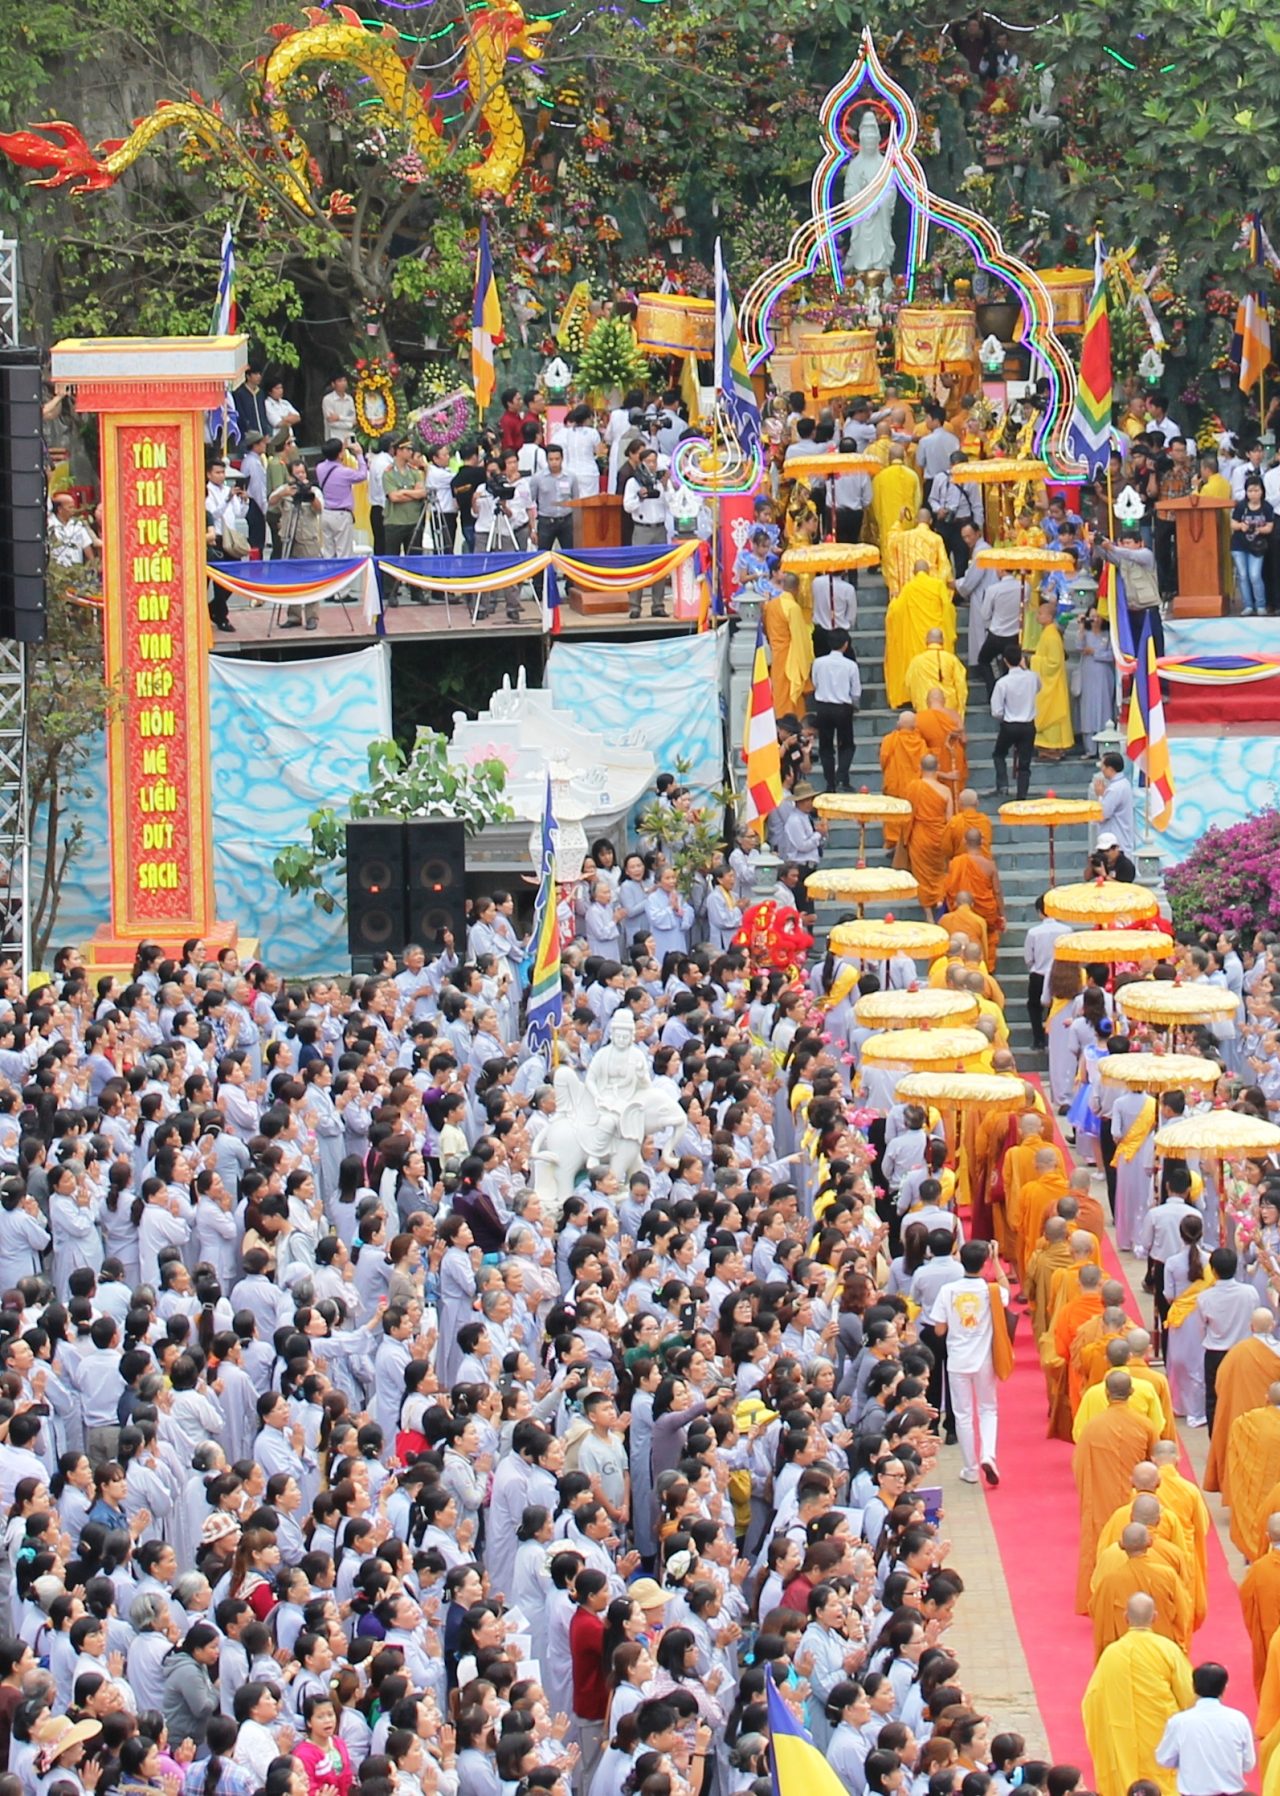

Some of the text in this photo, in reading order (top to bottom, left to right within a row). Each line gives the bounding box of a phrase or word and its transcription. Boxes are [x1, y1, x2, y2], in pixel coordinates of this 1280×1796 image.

[133, 437, 167, 469] TÂM
[136, 472, 163, 506] TRÍ
[139, 634, 172, 663] VẠN
[136, 663, 174, 697] KIẾP
[140, 705, 175, 736] HÔN
[143, 743, 168, 774] MÊ
[139, 778, 176, 812] LIỀN
[143, 816, 174, 849] DỨT
[139, 863, 178, 895] SẠCH
